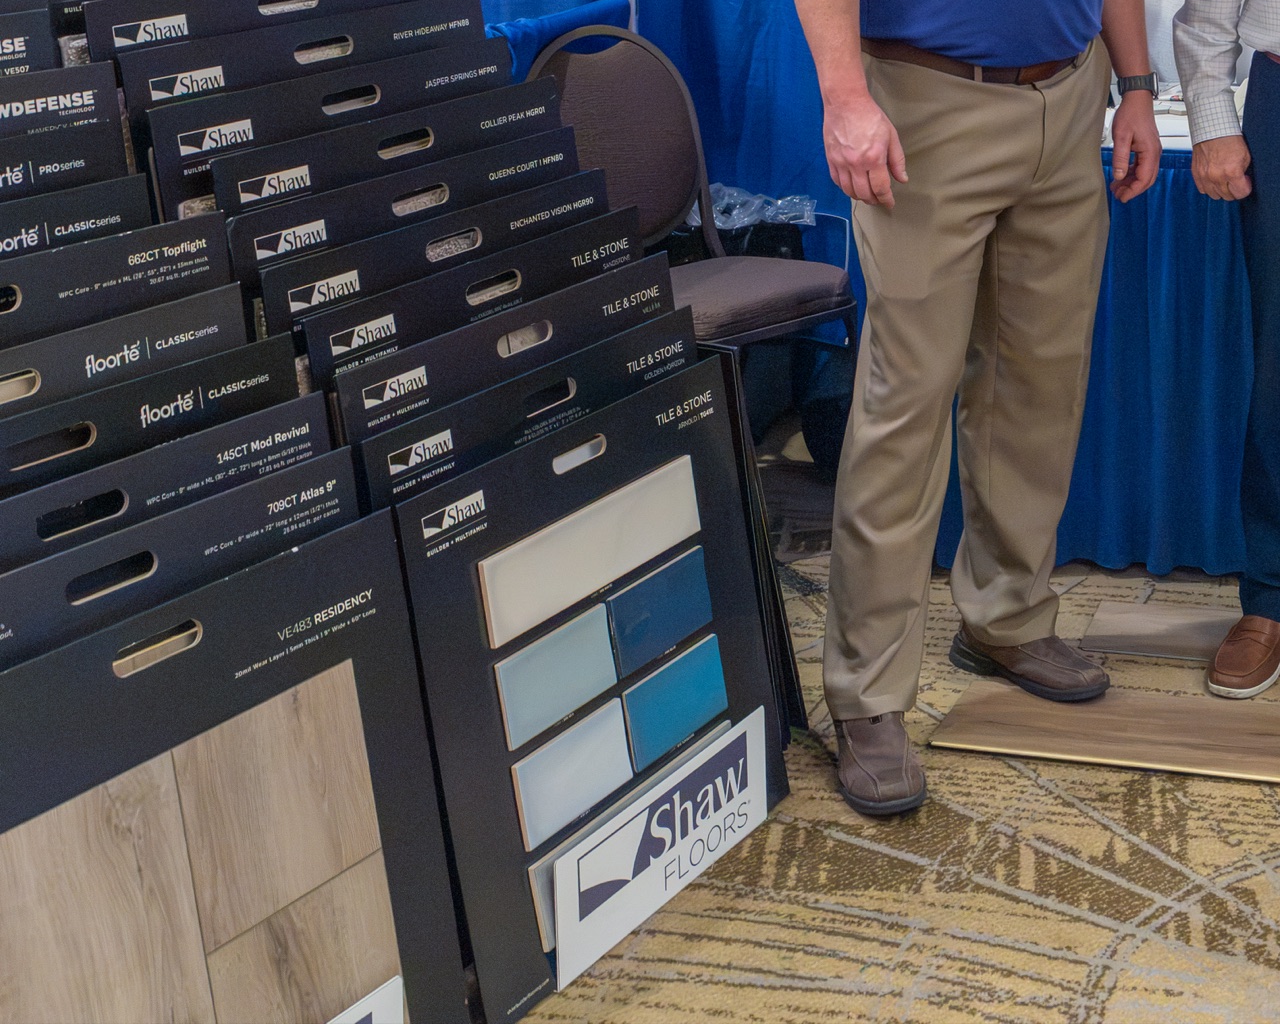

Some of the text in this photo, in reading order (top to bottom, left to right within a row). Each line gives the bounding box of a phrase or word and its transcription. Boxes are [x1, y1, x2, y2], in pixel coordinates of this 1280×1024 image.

[142, 19, 186, 41] Shaw
[393, 30, 414, 40] RIVER
[414, 23, 448, 36] HIDEAWAY
[4, 65, 30, 75] VE507
[425, 65, 498, 89] JASPER SPRINGS HFP01
[180, 75, 222, 95] Shaw
[59, 106, 95, 116] TECHNOLOGY
[480, 106, 545, 129] COLLIER PEAK HGR01
[208, 127, 251, 149] Shaw
[488, 167, 516, 181] QUEENS
[516, 160, 538, 173] COURT
[268, 173, 308, 195] Shaw
[510, 196, 594, 230] ENCHANTED VISION HGR90
[128, 238, 207, 266] 662CT Topflight
[283, 228, 324, 251] Shaw
[571, 238, 629, 268] TILE & STONE
[58, 290, 73, 299] WPC
[317, 278, 357, 304] Shaw
[602, 300, 622, 317] TILE
[622, 298, 630, 308] &
[630, 285, 660, 305] STONE
[357, 322, 393, 346] Shaw
[335, 345, 399, 374] BUILDER MULTIFAMILY
[627, 340, 684, 374] TILE & STONE
[389, 374, 425, 398] Shaw
[367, 398, 430, 428] BUILDER MULTIFAMILY
[655, 390, 713, 426] TILE & STONE
[217, 423, 310, 464] 145CT Mod Revival
[414, 438, 450, 464] Shaw
[393, 461, 455, 494] BUILDER MULTIFAMILY
[267, 494, 298, 515] 709CT
[300, 485, 324, 503] Atlas
[447, 499, 482, 525] Shaw
[204, 545, 219, 556] WPC
[219, 540, 234, 550] Core
[427, 522, 488, 557] BUILDER MULTIFAMILY
[277, 589, 373, 641] VE483 RESIDENCY
[253, 660, 268, 670] Wear
[269, 651, 285, 663] Layer
[305, 635, 319, 645] Thick
[332, 622, 346, 633] Wide
[362, 608, 376, 618] Long
[650, 757, 744, 859] Shaw
[664, 801, 748, 891] FLOORS
